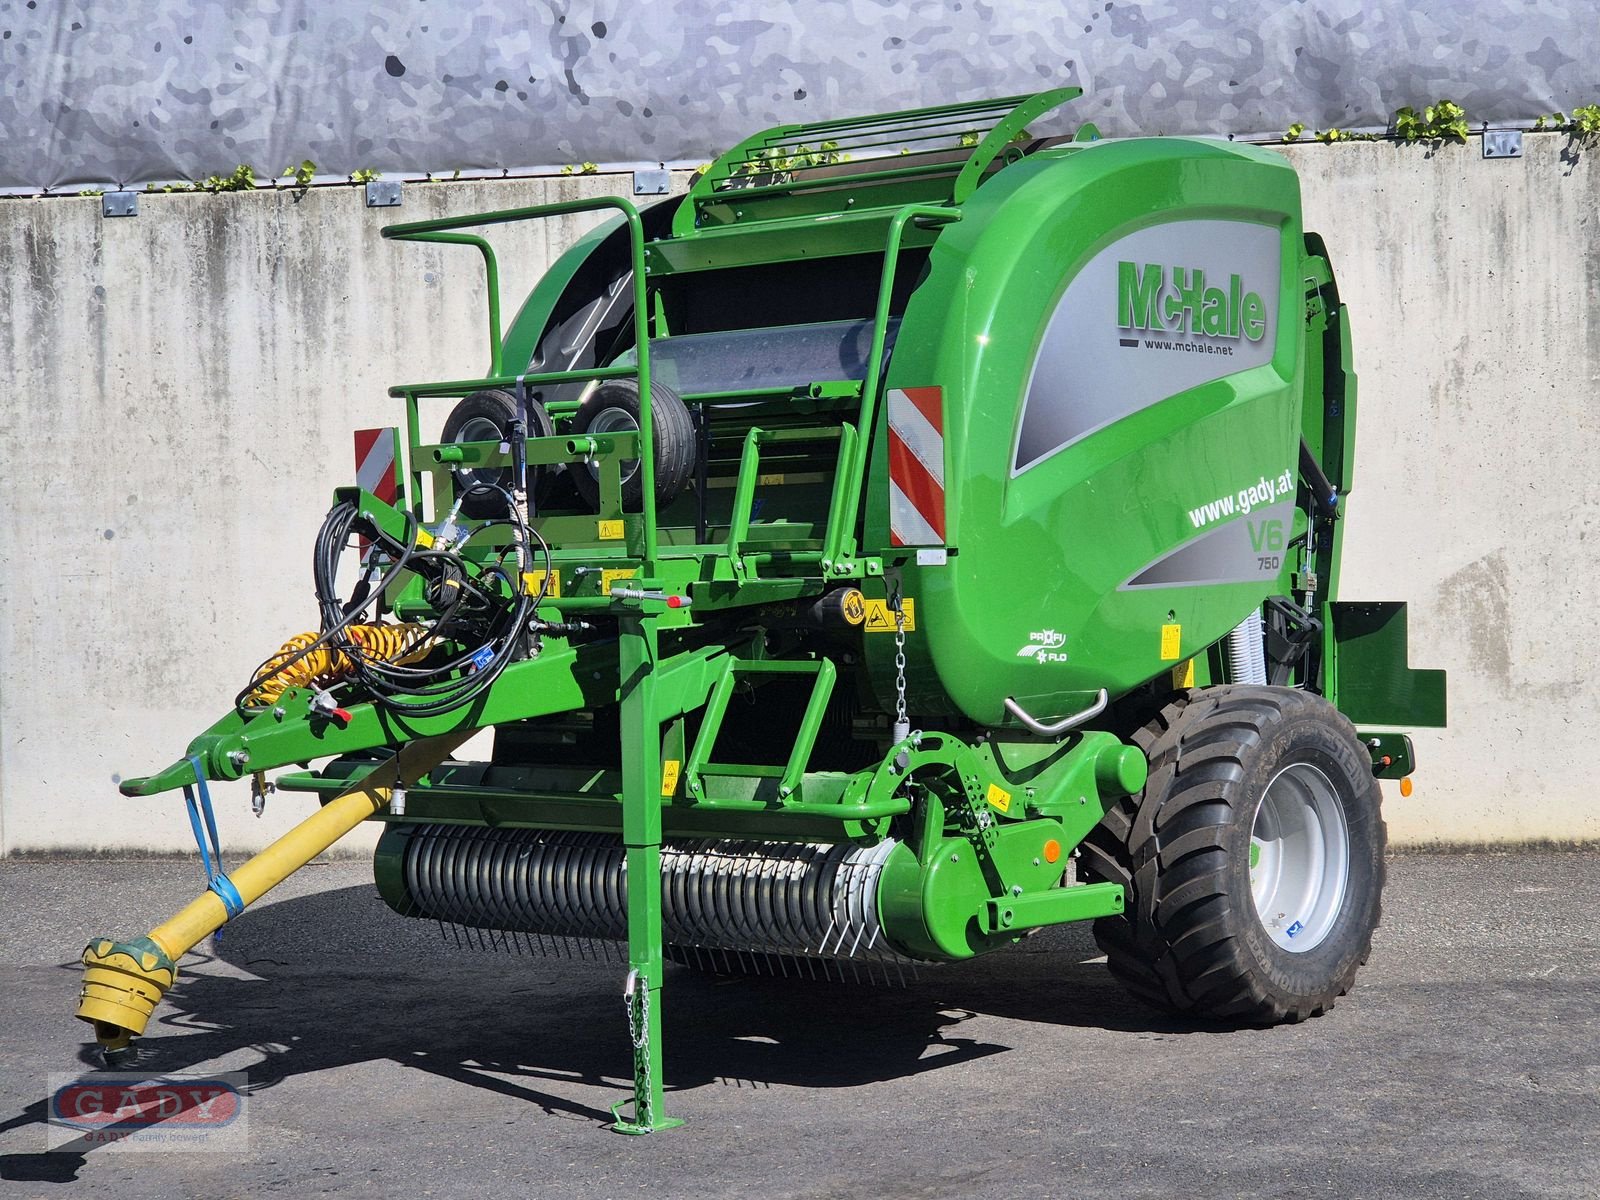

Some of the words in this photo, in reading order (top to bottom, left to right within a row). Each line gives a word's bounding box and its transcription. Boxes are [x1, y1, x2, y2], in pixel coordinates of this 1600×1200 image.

[1145, 340, 1234, 356] www.mchale.net
[1188, 469, 1293, 527] www.gady.at
[1247, 519, 1284, 553] V6
[1257, 556, 1279, 570] 750
[1048, 653, 1067, 662] FLO
